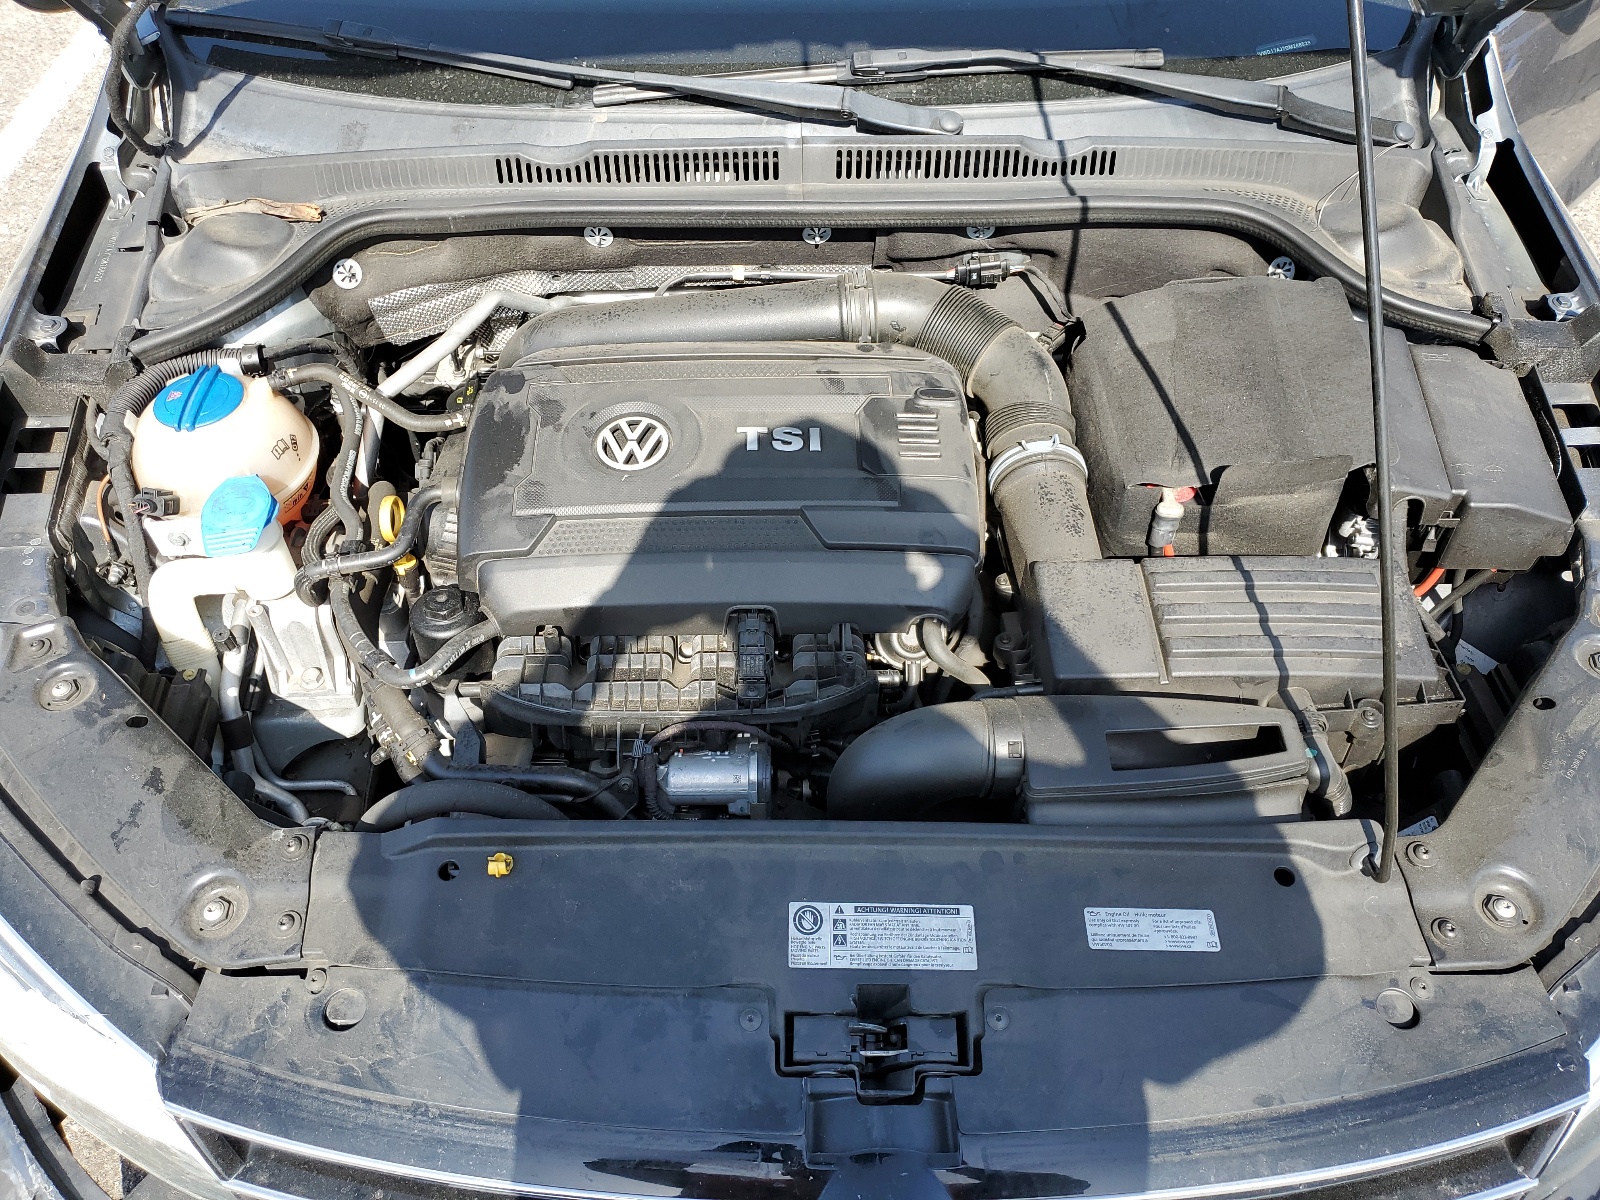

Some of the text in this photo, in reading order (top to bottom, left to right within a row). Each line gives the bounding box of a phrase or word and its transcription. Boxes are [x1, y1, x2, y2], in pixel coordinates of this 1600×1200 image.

[736, 426, 822, 452] TSI
[890, 907, 922, 915] WARNING!
[922, 908, 959, 916] ATTENTION!
